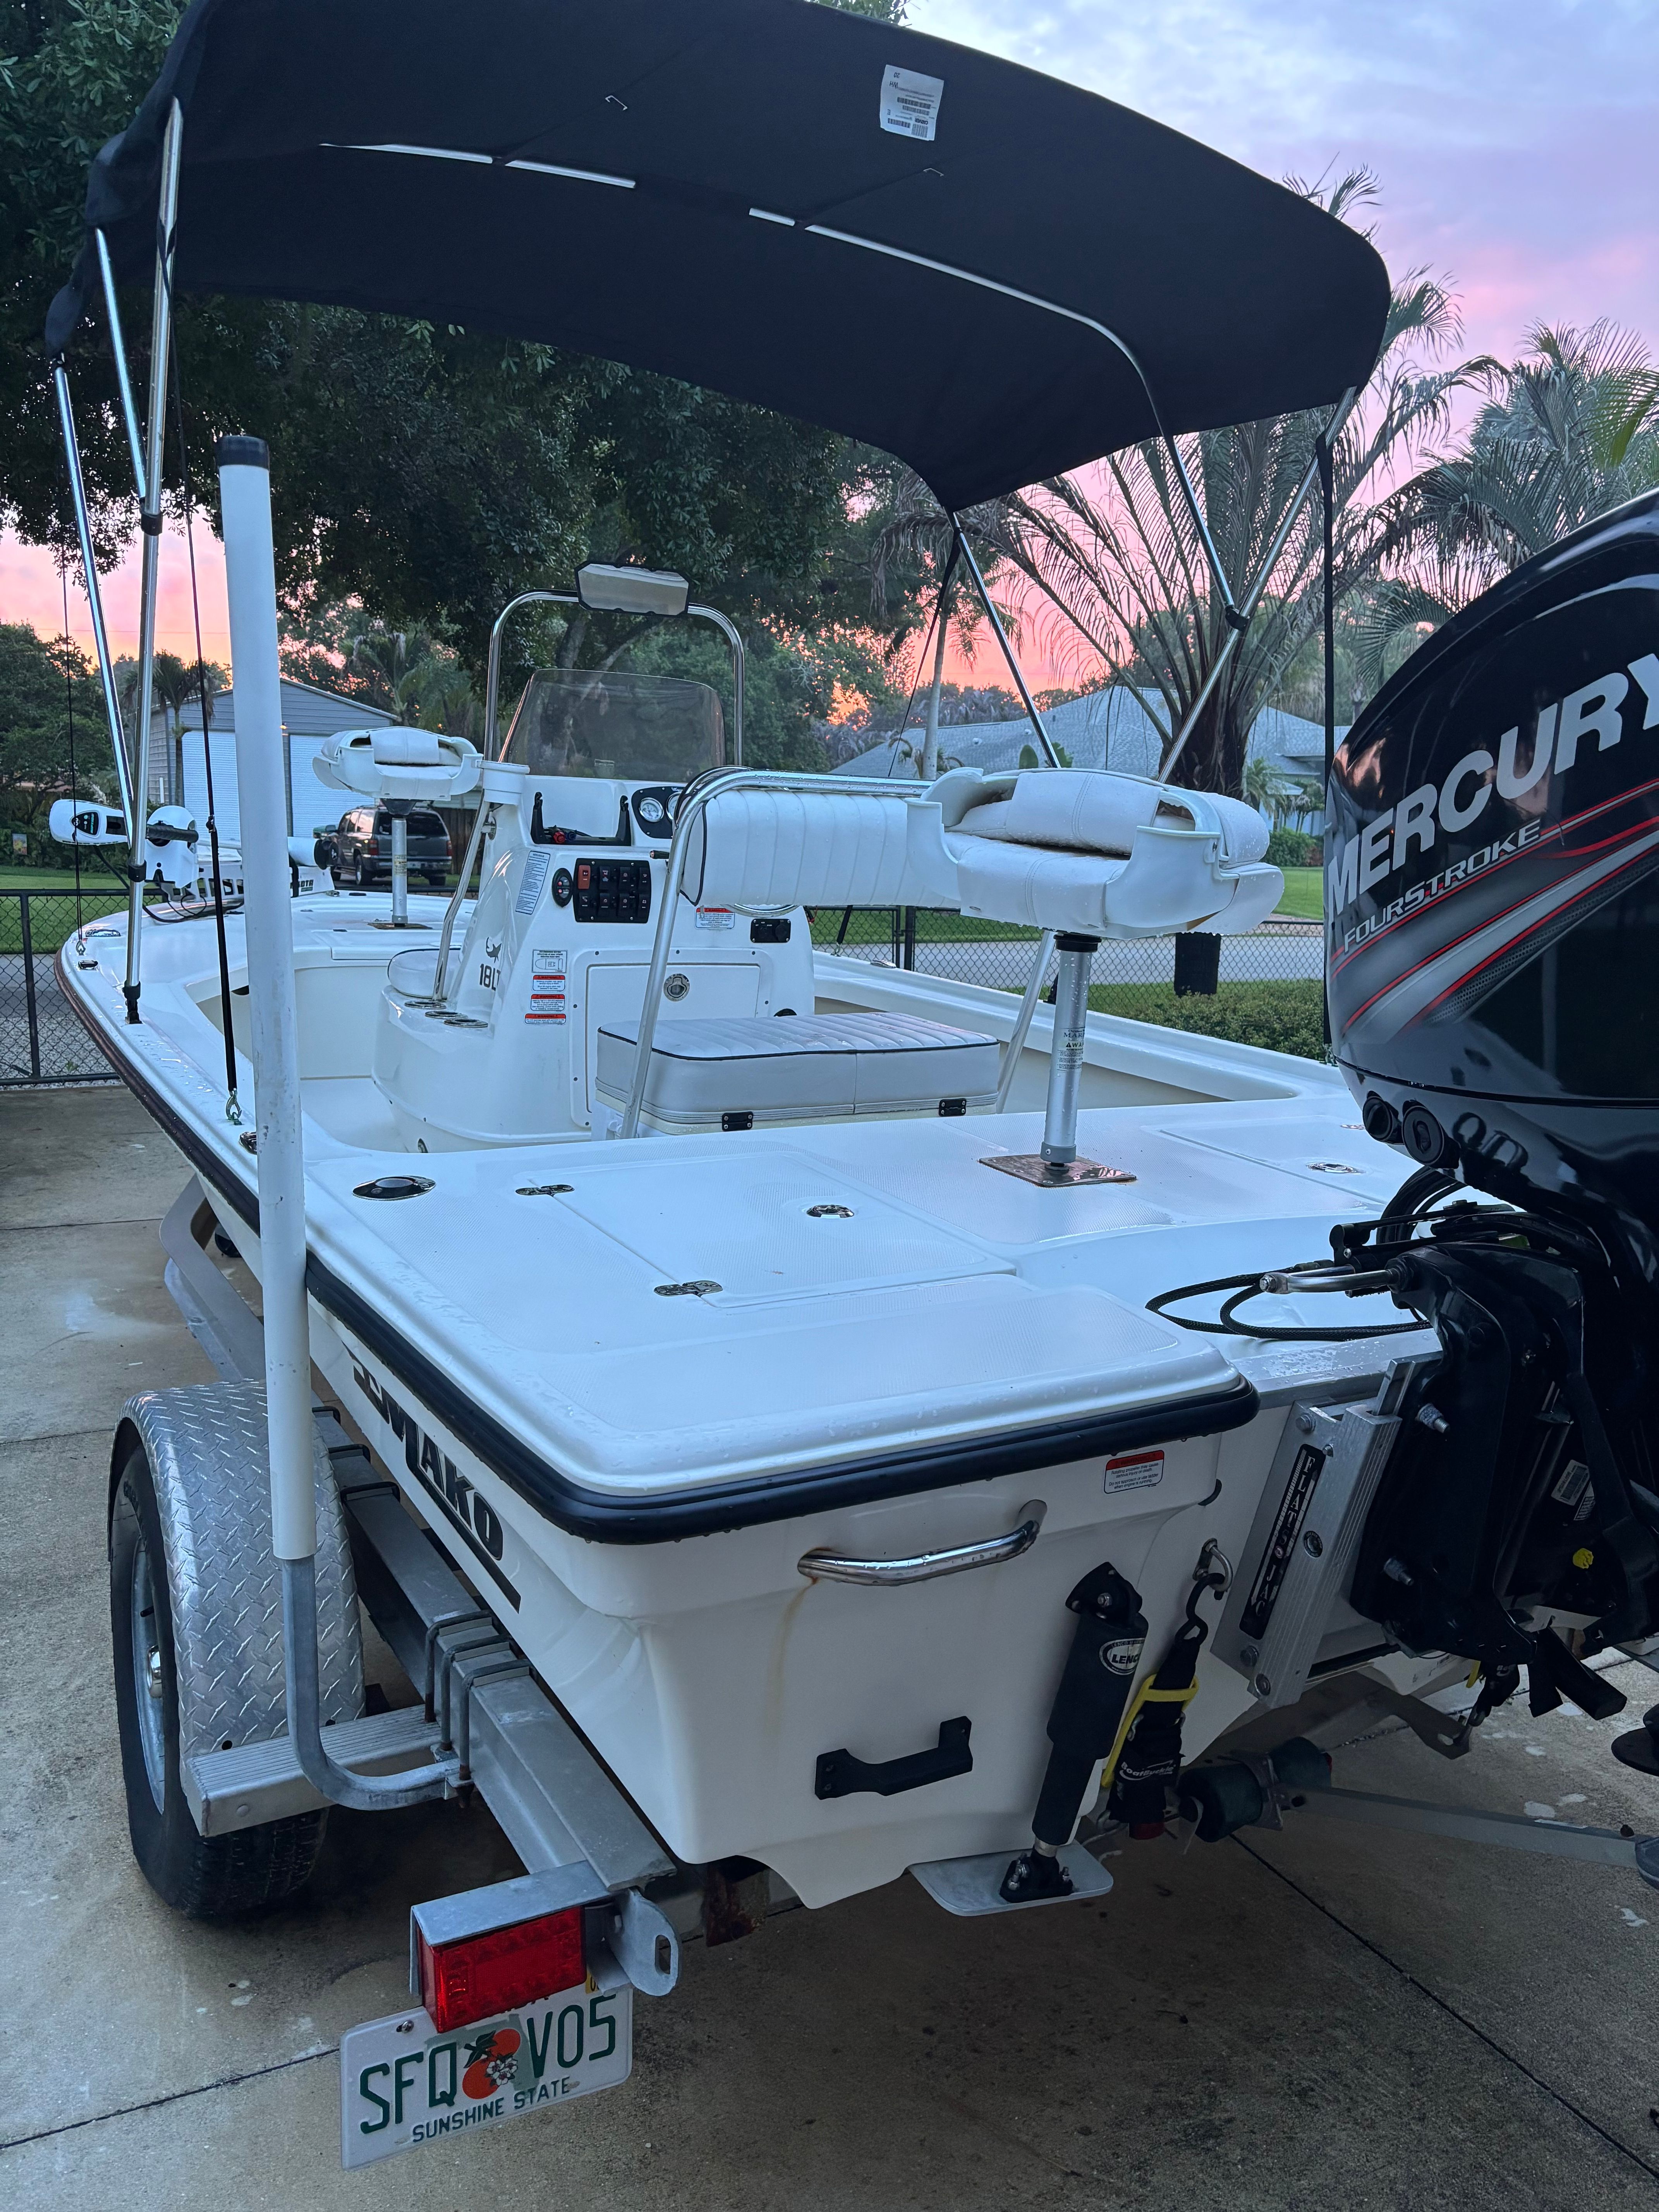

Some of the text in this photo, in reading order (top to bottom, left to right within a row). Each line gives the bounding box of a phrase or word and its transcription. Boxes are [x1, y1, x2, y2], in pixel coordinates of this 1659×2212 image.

[1279, 1455, 1316, 1545] FLATS
[360, 2041, 458, 2134] SFQ
[412, 2076, 570, 2143] SUNSHINE STATE
